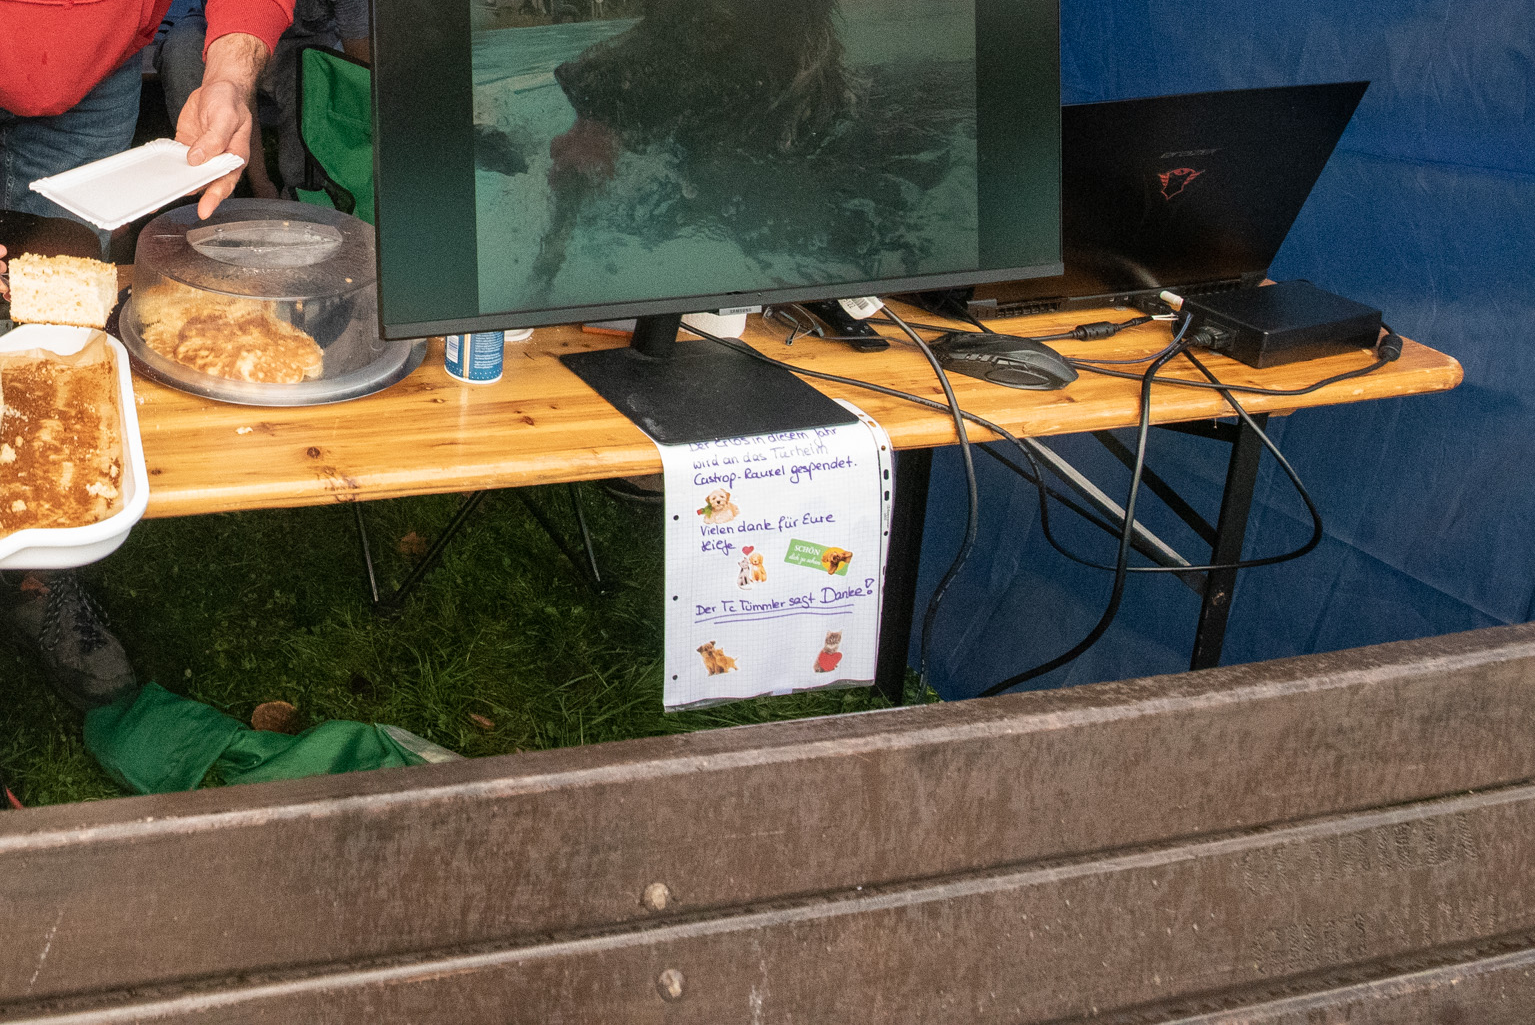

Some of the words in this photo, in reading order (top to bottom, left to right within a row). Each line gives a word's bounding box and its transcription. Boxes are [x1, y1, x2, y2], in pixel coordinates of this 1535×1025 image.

[693, 454, 719, 469] wird
[723, 455, 739, 465] an
[743, 452, 767, 463] das
[790, 456, 858, 484] gespendet.
[700, 525, 735, 536] Vielen
[778, 515, 799, 532] für
[802, 512, 836, 526] Eure
[794, 544, 821, 556] SCHÖN
[695, 604, 717, 616] Der
[739, 599, 786, 612] Tümmler
[789, 592, 816, 609] sagt
